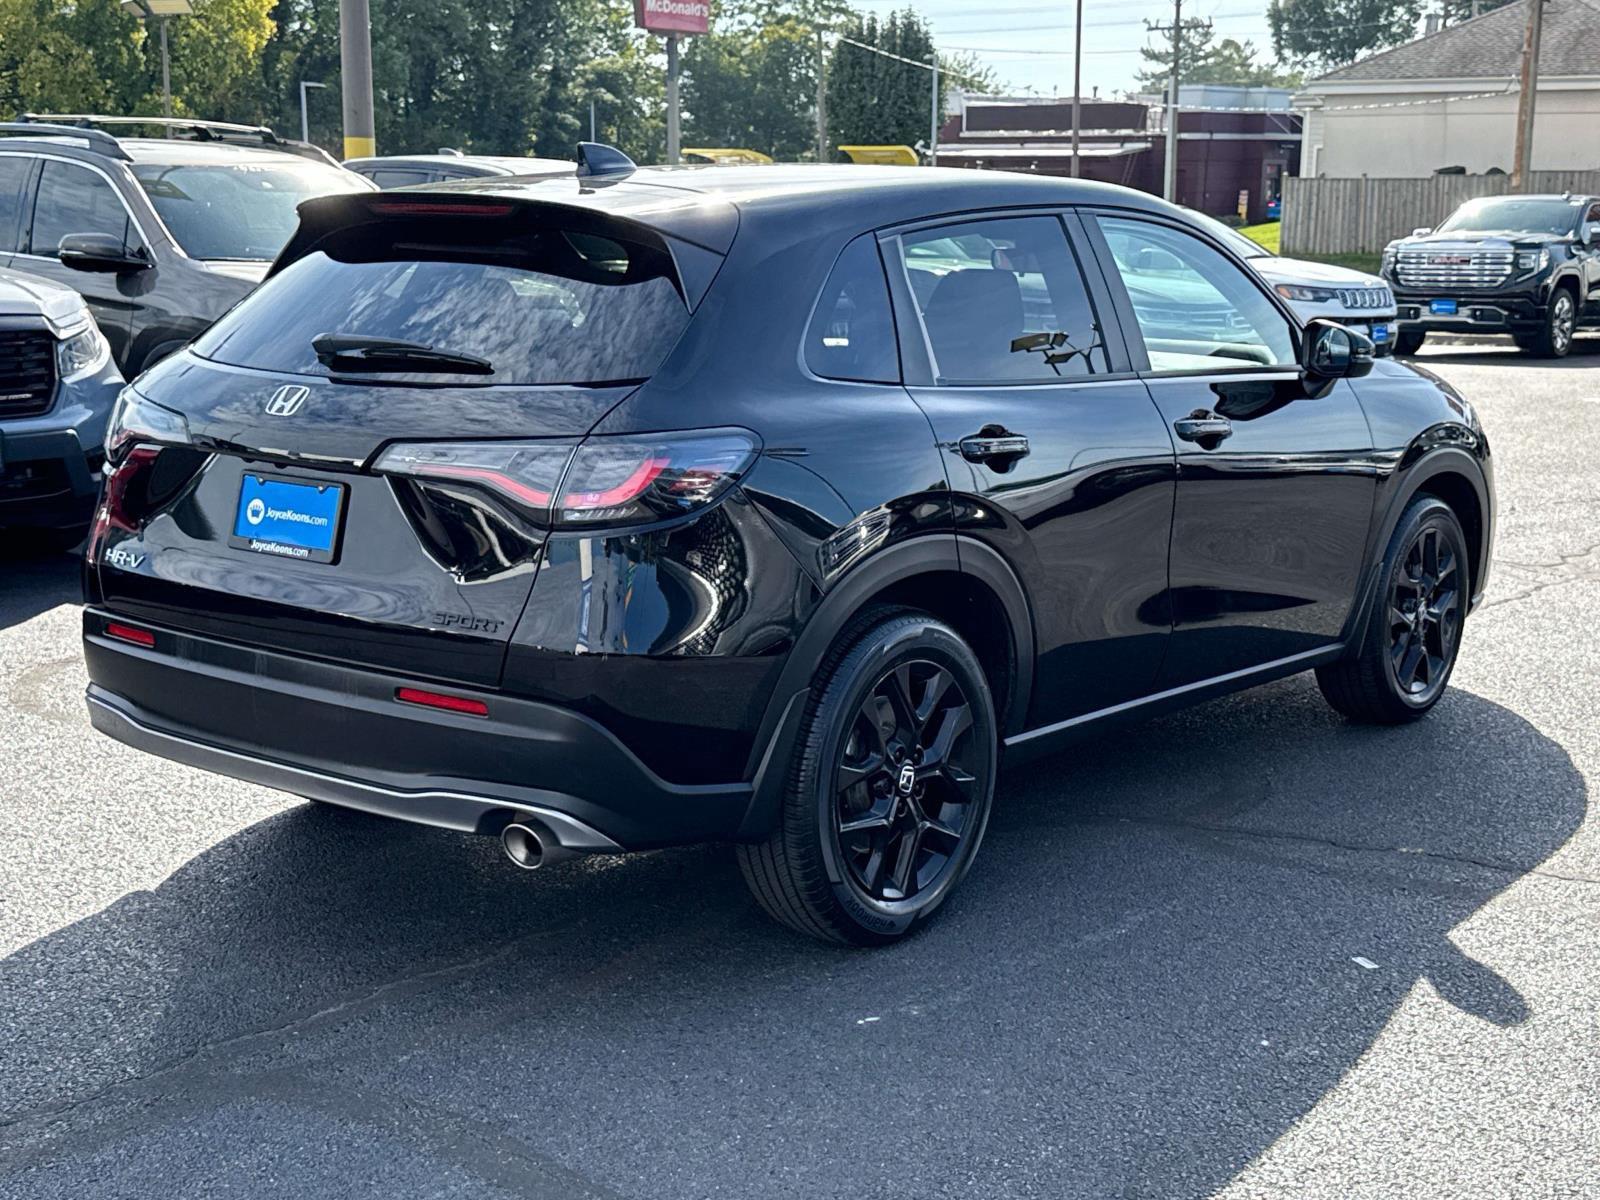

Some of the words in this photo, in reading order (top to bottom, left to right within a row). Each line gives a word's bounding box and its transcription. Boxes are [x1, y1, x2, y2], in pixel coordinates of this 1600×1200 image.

[646, 0, 709, 17] McDonald's
[265, 507, 328, 527] JoyceKoons.com
[105, 548, 145, 568] HR-V
[250, 539, 309, 558] JoyceKoons.com
[431, 612, 500, 633] SPORT
